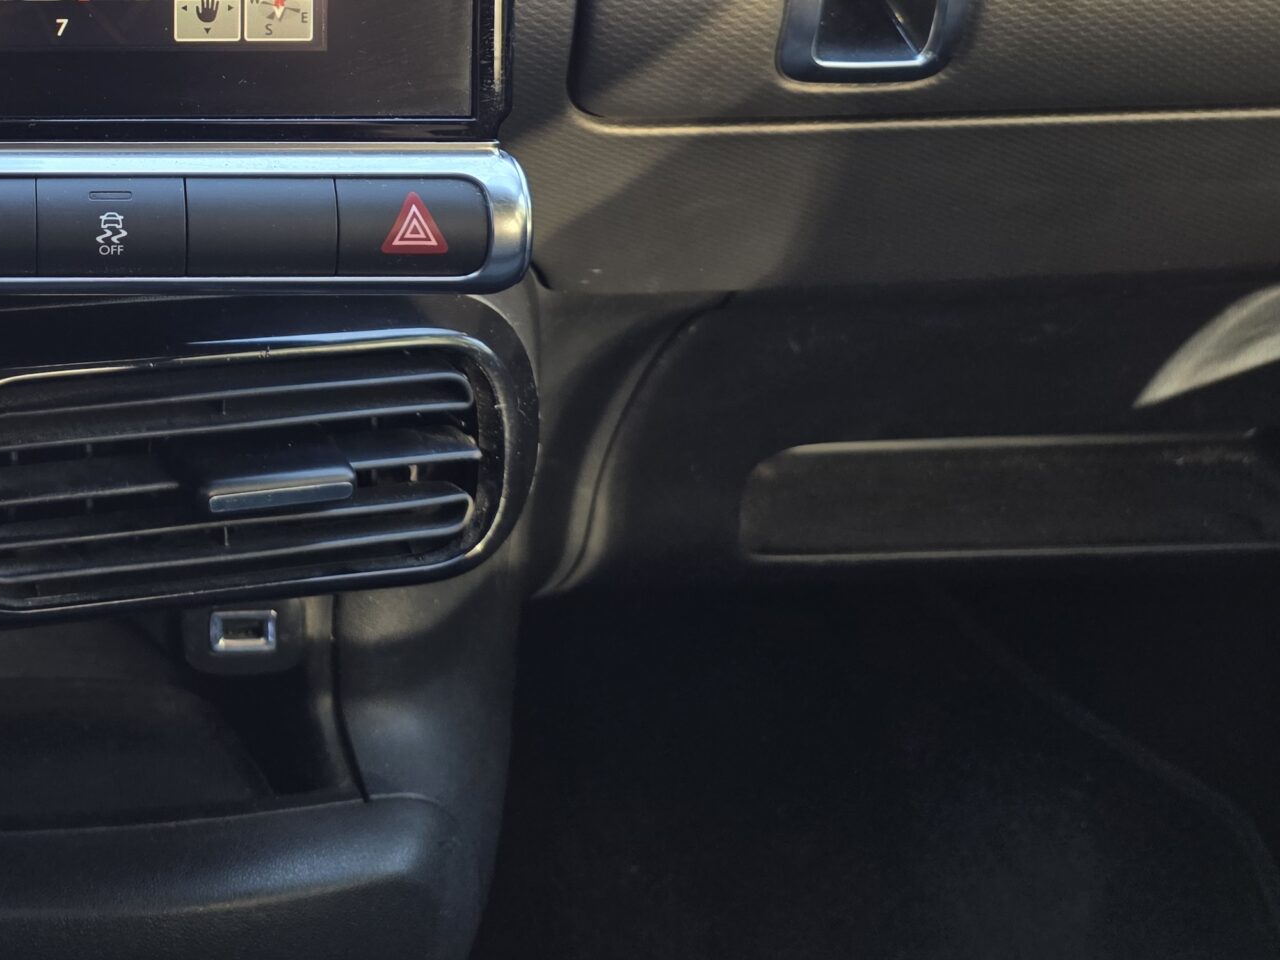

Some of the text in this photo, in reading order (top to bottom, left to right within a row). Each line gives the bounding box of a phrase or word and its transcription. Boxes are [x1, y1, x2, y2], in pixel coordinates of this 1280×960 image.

[301, 12, 308, 23] E
[55, 19, 69, 37] 7
[265, 24, 273, 35] S
[99, 244, 124, 256] OFF
